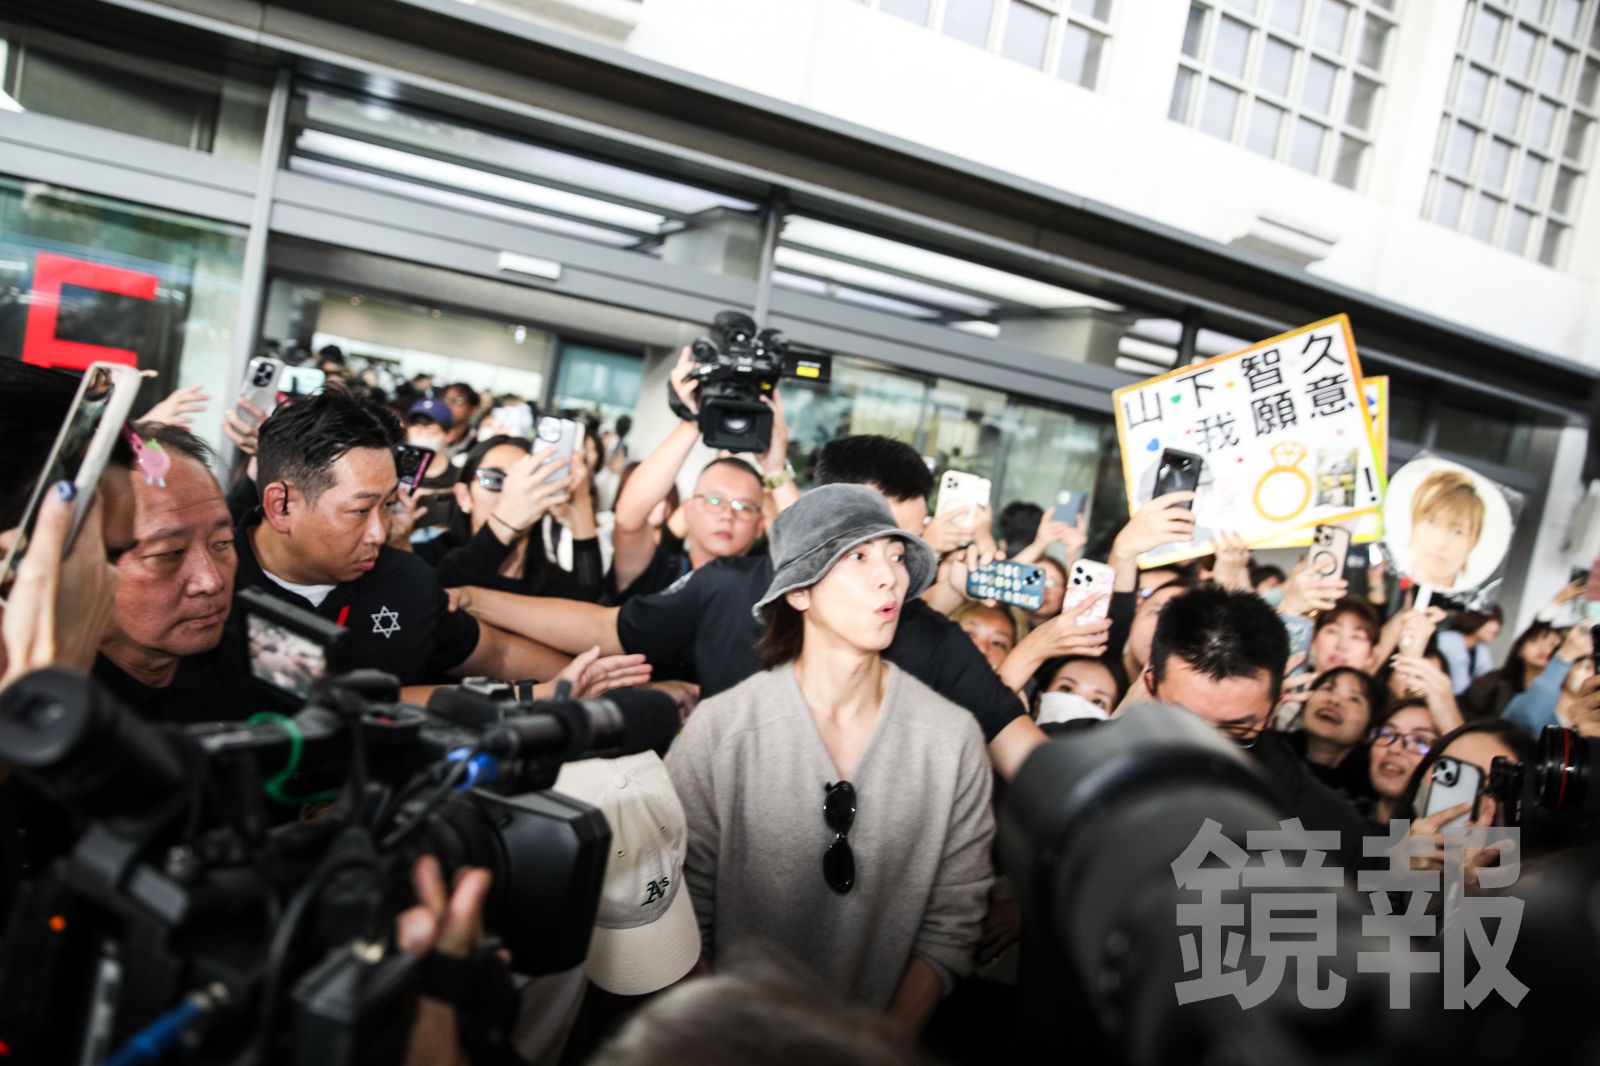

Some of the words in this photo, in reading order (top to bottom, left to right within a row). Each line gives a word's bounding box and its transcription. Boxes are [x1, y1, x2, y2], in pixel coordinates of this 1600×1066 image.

[1124, 334, 1345, 430] 山下智久
[1194, 373, 1354, 453] 我願意
